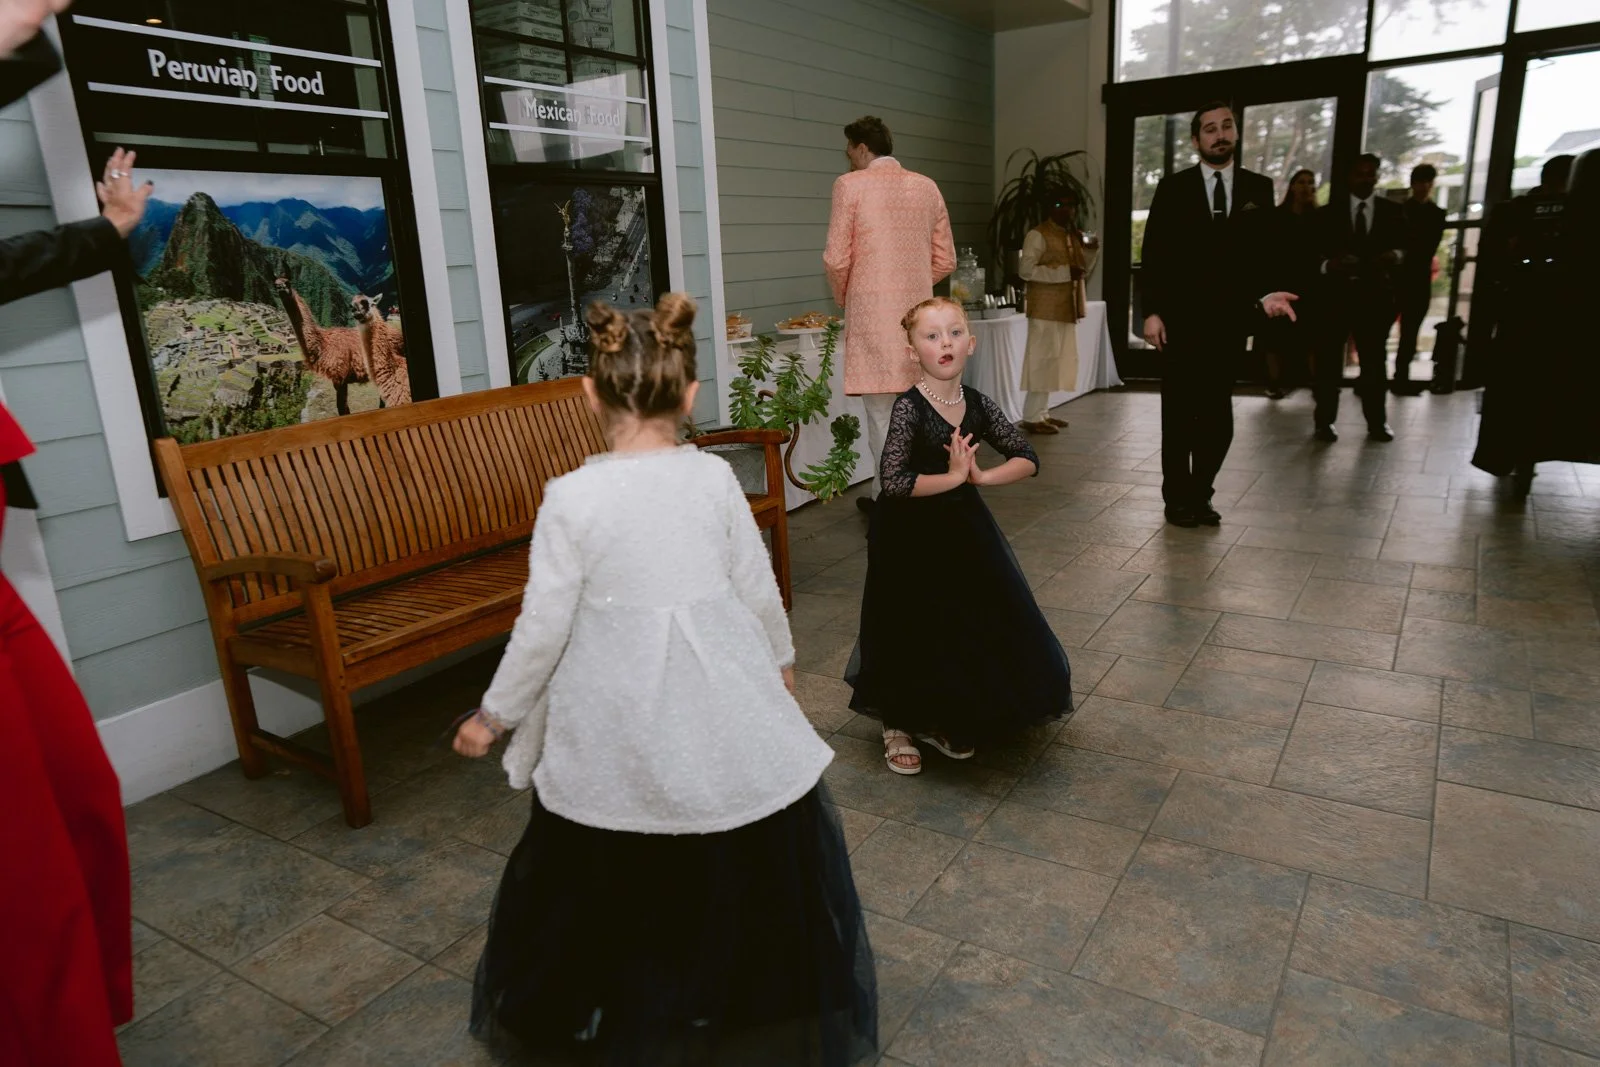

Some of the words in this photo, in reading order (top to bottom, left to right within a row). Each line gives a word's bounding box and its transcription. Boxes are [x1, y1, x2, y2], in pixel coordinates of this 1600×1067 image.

[147, 48, 257, 92] Peruvian
[269, 65, 325, 96] Food
[524, 97, 581, 125] Mexican
[589, 105, 620, 126] Food
